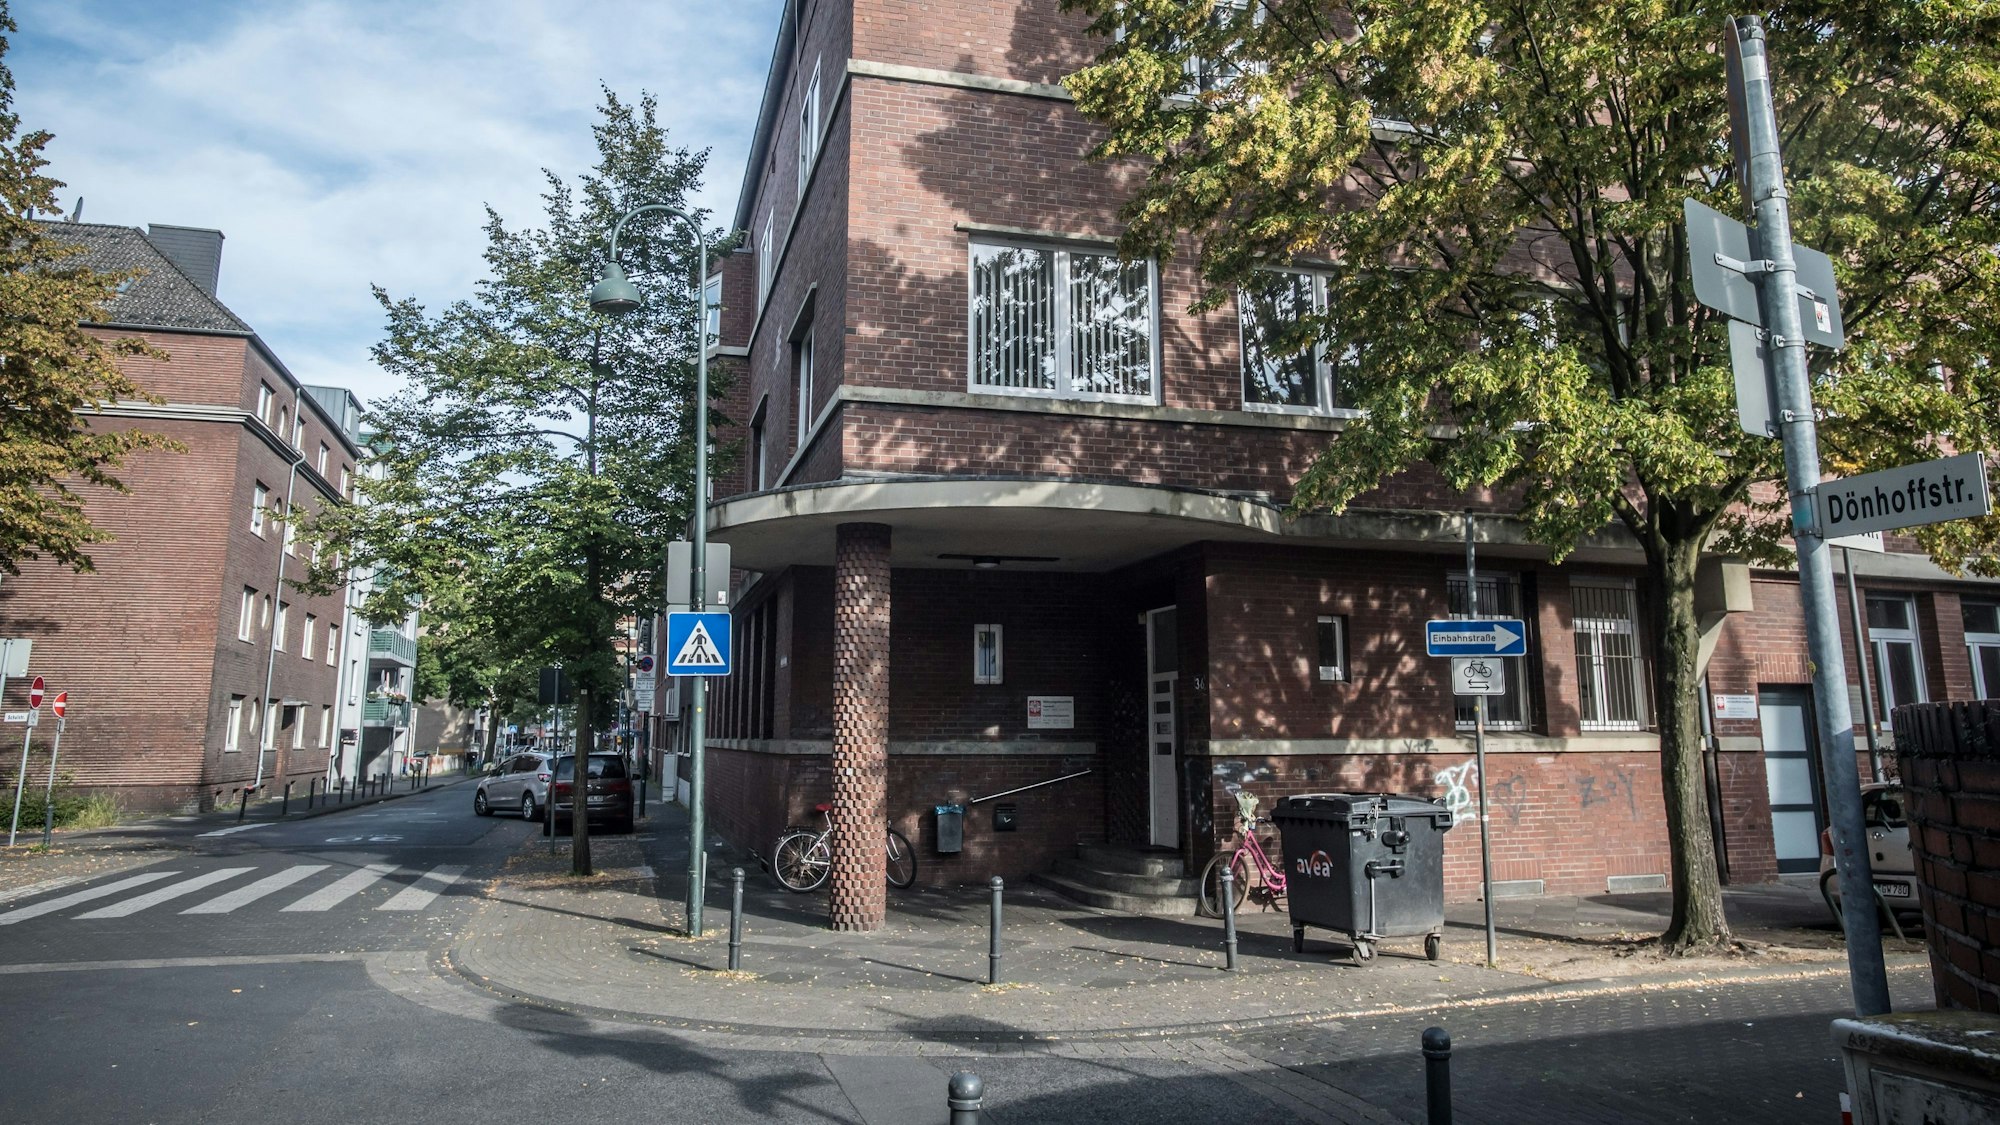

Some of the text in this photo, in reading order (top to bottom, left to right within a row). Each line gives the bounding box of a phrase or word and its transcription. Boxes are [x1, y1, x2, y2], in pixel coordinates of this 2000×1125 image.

[1828, 474, 1973, 525] Dönhoffstr.
[1432, 633, 1497, 643] Einbahnstraße
[1194, 677, 1205, 690] 36
[1296, 854, 1332, 878] avea
[1893, 885, 1908, 895] 780
